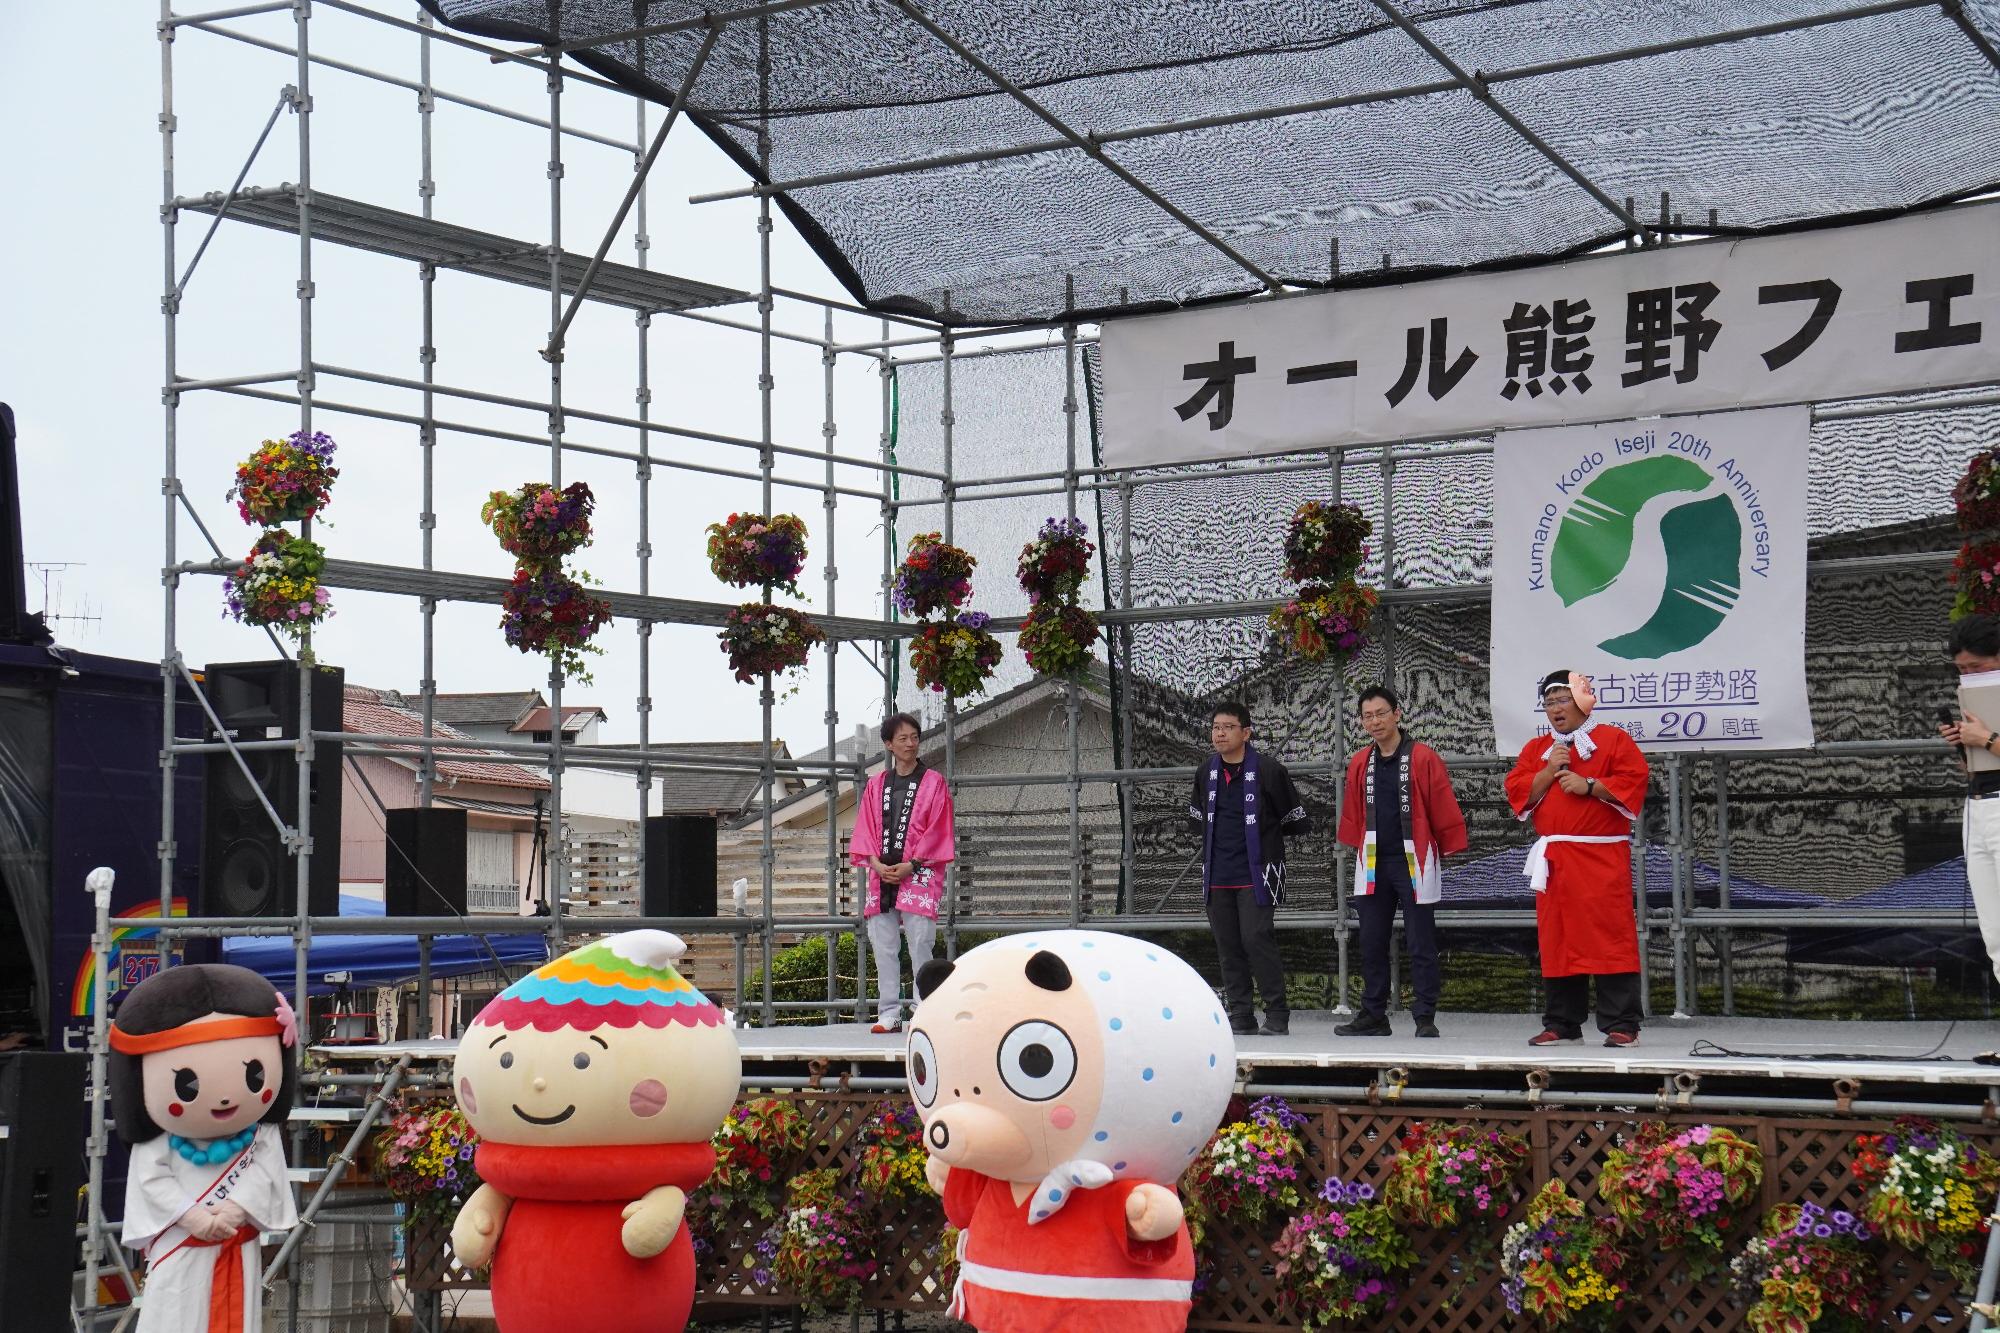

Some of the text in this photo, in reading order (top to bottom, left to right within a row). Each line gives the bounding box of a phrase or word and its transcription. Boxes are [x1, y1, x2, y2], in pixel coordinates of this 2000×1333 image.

[1173, 273, 1982, 431] オール熊野フェ
[1528, 430, 1770, 592] Kumano Kodo Iseji 20th Anniversary
[1536, 669, 1757, 707] 古道伊勢路
[1656, 711, 1708, 739] 20
[1721, 717, 1761, 736] 周年
[1244, 771, 1257, 825] 筆の都
[1400, 754, 1410, 812] 筆の都くまの
